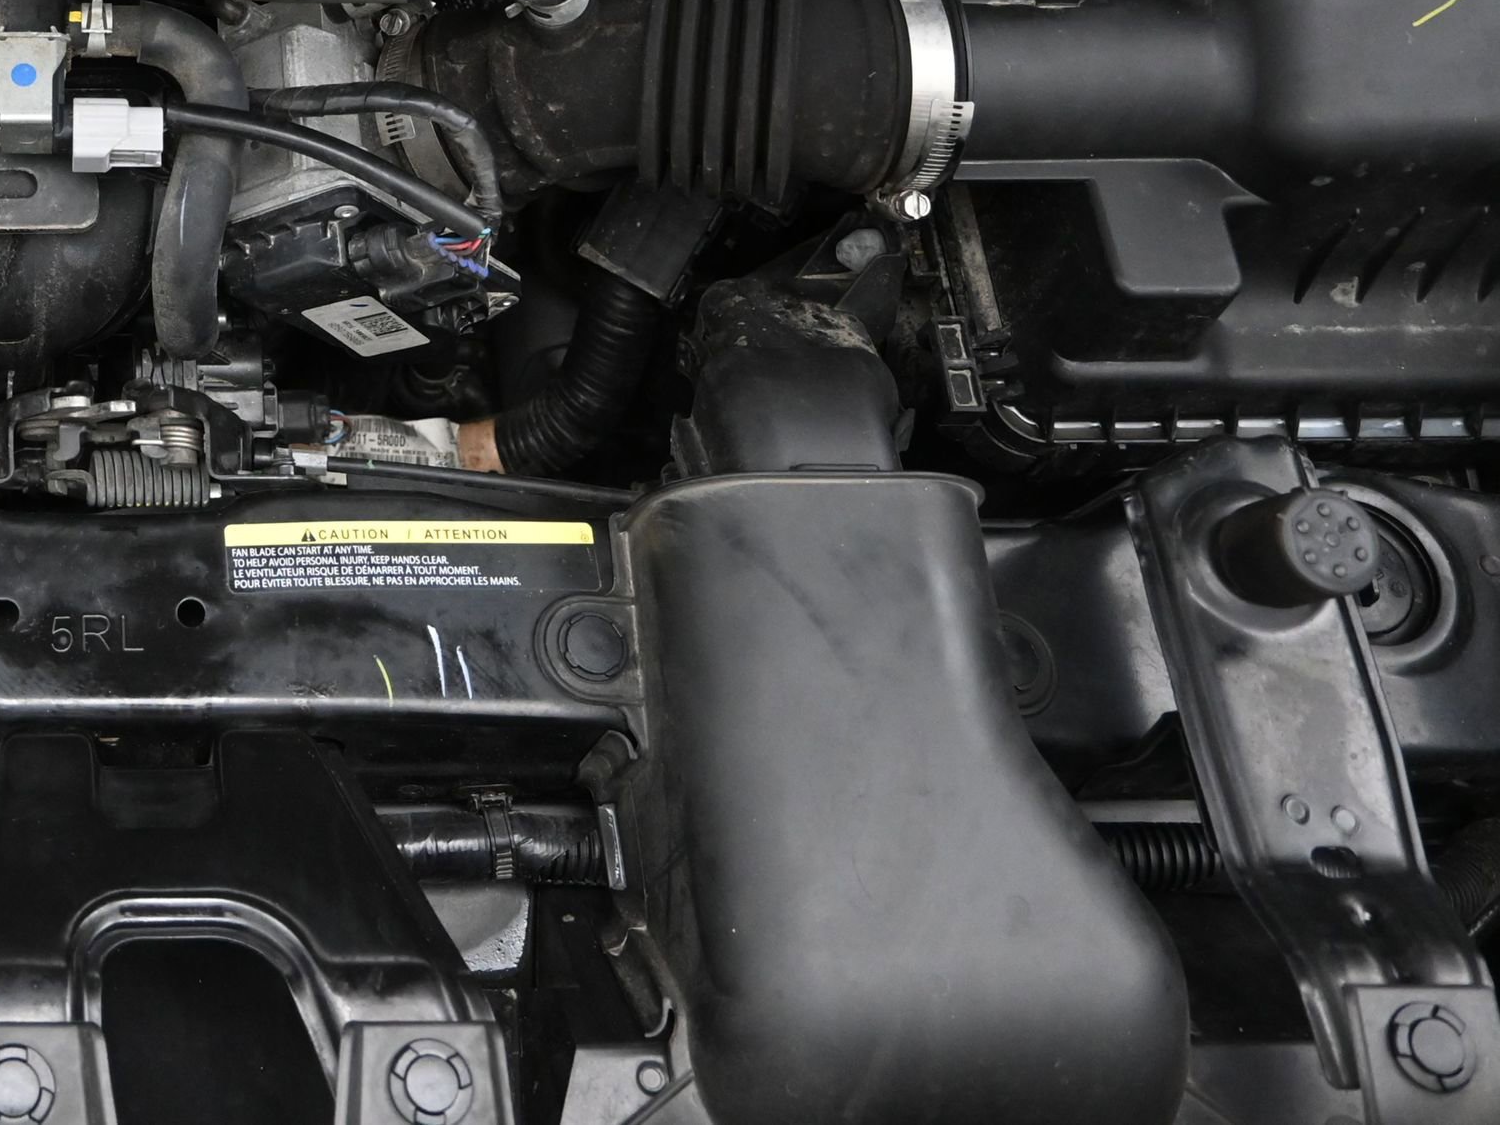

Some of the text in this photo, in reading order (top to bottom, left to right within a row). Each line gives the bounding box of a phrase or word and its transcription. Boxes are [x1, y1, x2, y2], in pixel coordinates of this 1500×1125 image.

[318, 529, 389, 540] CAUTION
[424, 529, 507, 539] ATTENTION
[232, 545, 375, 557] FAN BLADE CAN START AT ANY TIME.
[233, 556, 449, 567] TO HELP AVOID PERSONAL INJURY, KEEP HANDS CLEAR.
[233, 563, 482, 577] LE VENTILATEUR RISQUE DE DÉMARRER À TOUT MOMENT.
[234, 576, 521, 588] POUR ÉVITER TOUTE BLESSURE, NE PAS EN APPROCHER LES MAINS.
[50, 614, 145, 653] 5RL
